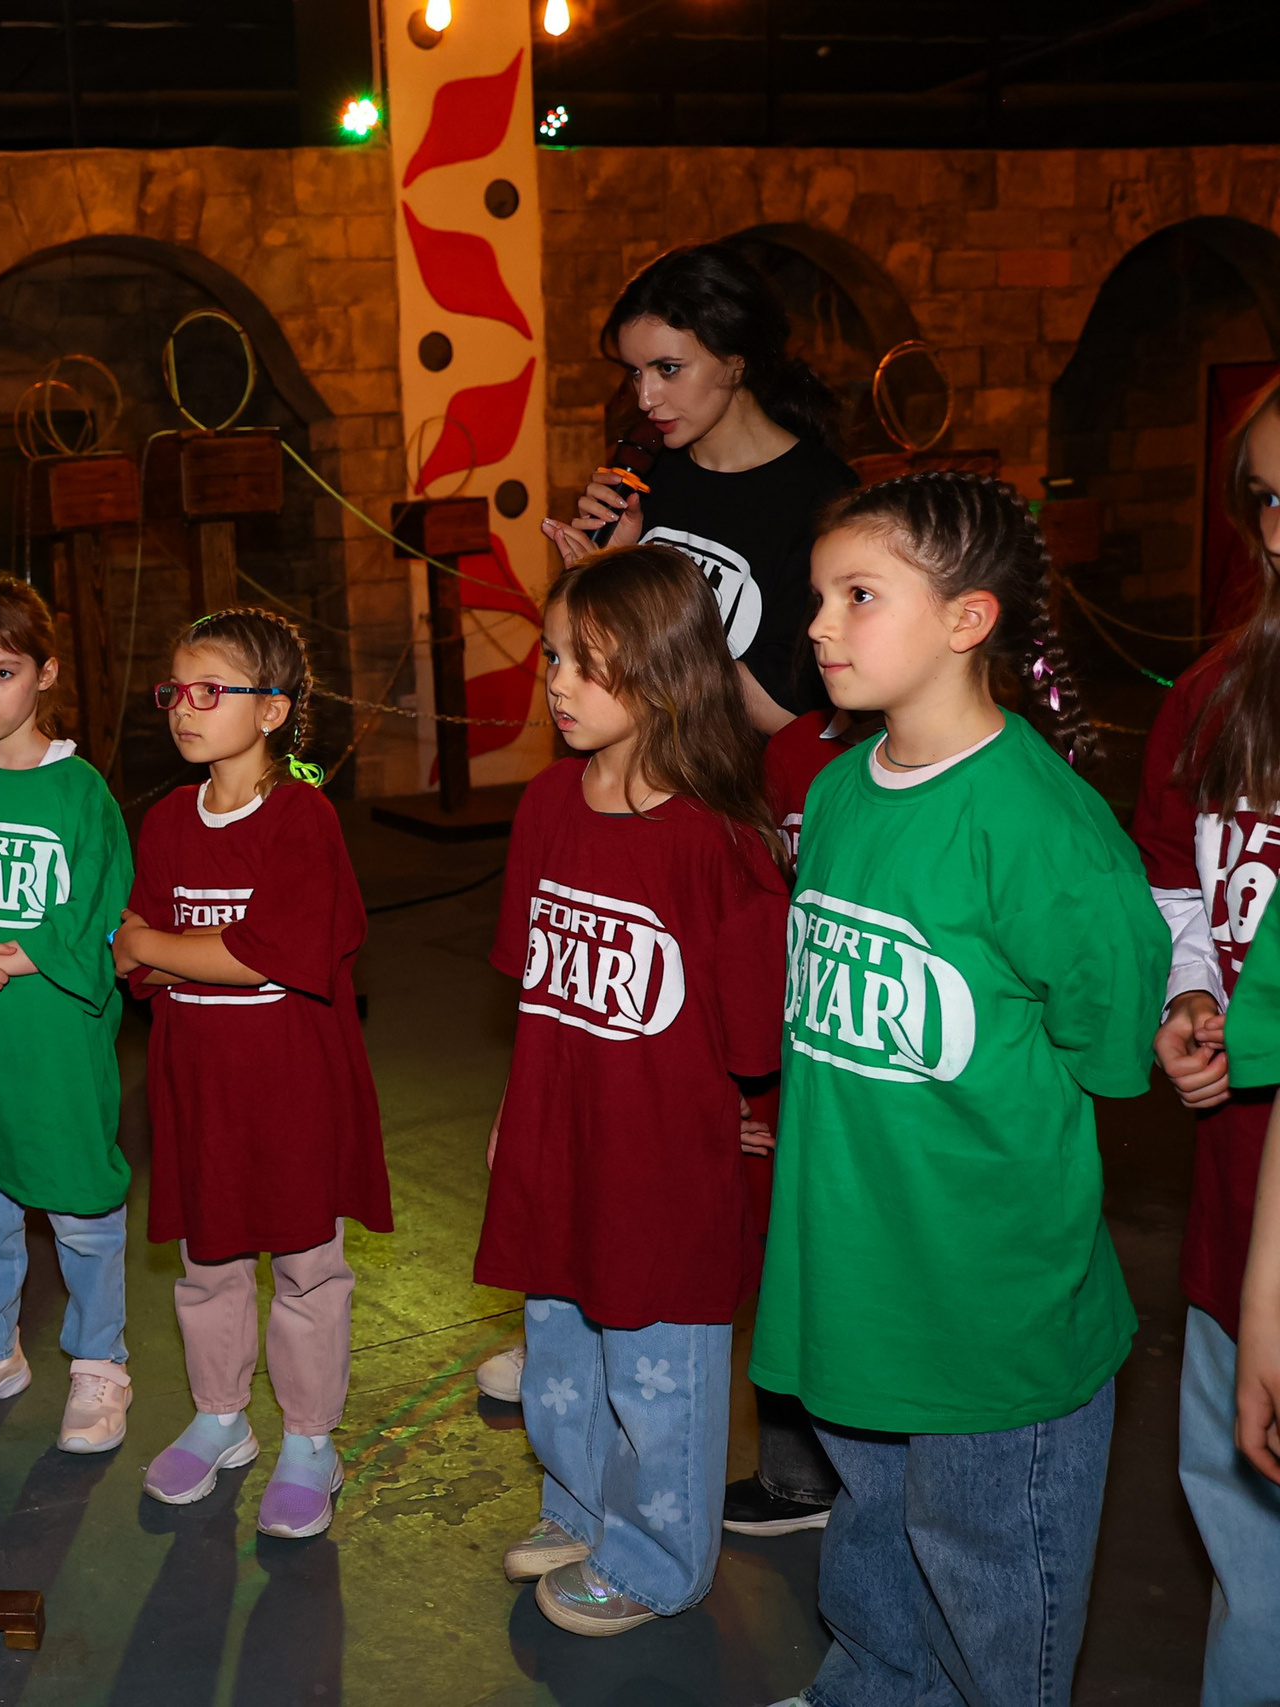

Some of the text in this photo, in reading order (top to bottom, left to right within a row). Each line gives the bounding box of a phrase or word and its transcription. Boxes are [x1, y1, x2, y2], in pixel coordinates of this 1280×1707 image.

[180, 903, 248, 926] FORT
[533, 897, 625, 943] FORT
[806, 912, 892, 966] FORT
[522, 897, 686, 1036] OYARD
